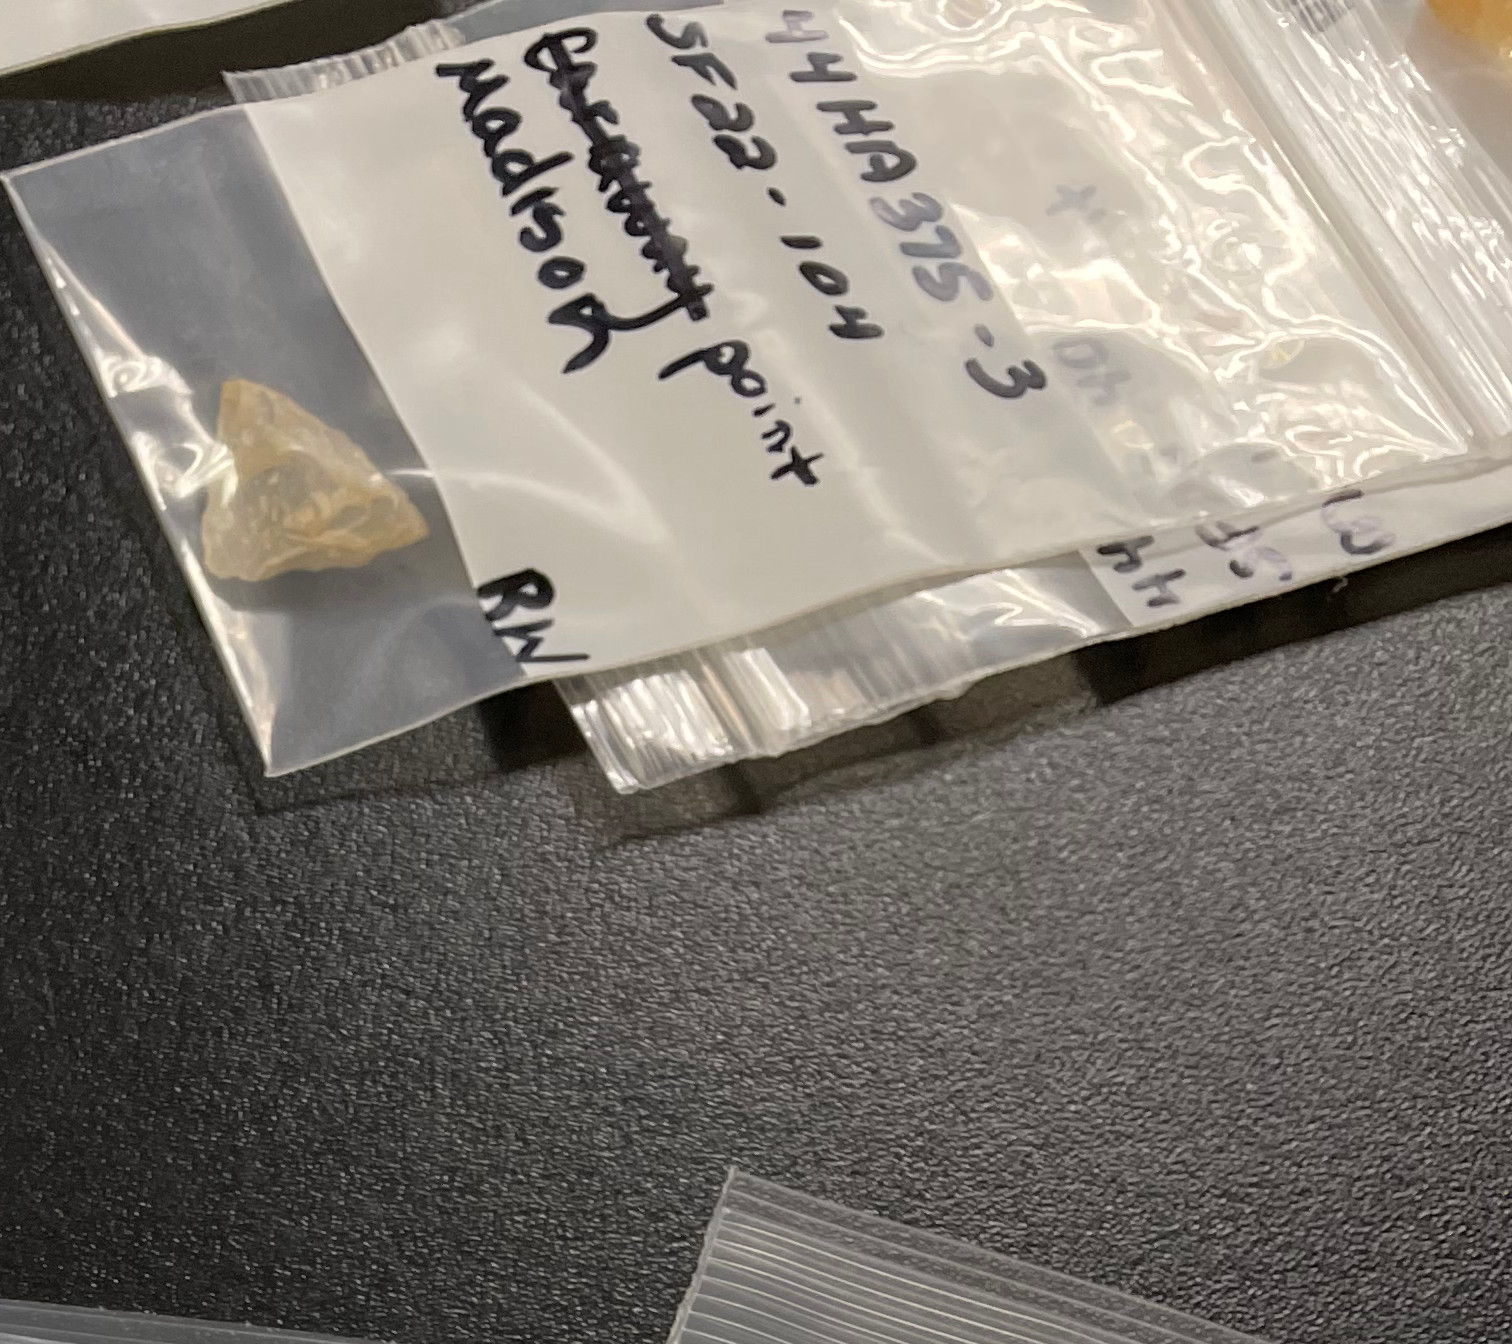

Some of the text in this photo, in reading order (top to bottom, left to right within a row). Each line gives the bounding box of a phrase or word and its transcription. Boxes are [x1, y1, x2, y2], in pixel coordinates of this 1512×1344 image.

[436, 59, 615, 373] Madison
[645, 13, 885, 341] SF22-104
[765, 9, 1048, 399] 44HA375-3
[659, 340, 824, 487] point
[478, 568, 590, 665] RW
